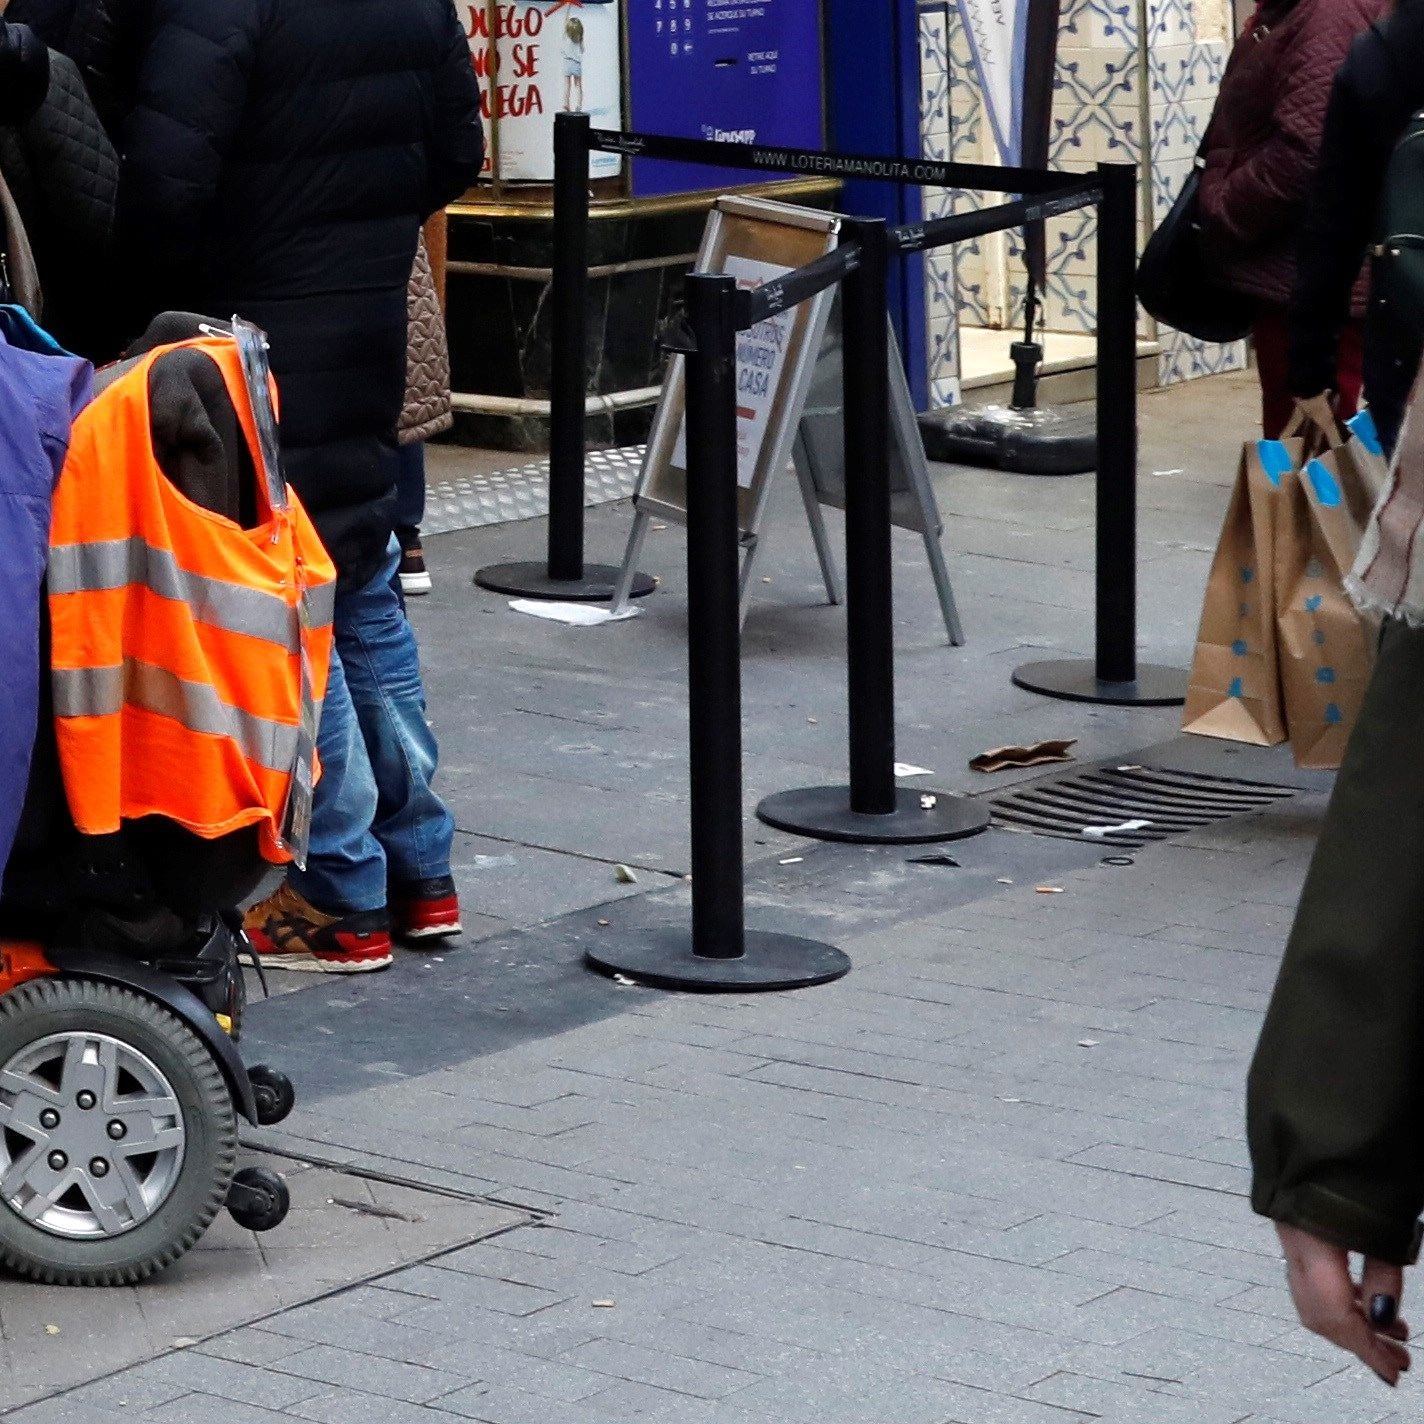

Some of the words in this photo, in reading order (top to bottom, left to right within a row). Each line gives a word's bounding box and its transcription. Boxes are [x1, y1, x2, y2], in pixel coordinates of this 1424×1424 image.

[466, 5, 543, 40] JUEGO
[512, 43, 540, 77] SE
[479, 84, 543, 119] UEGA
